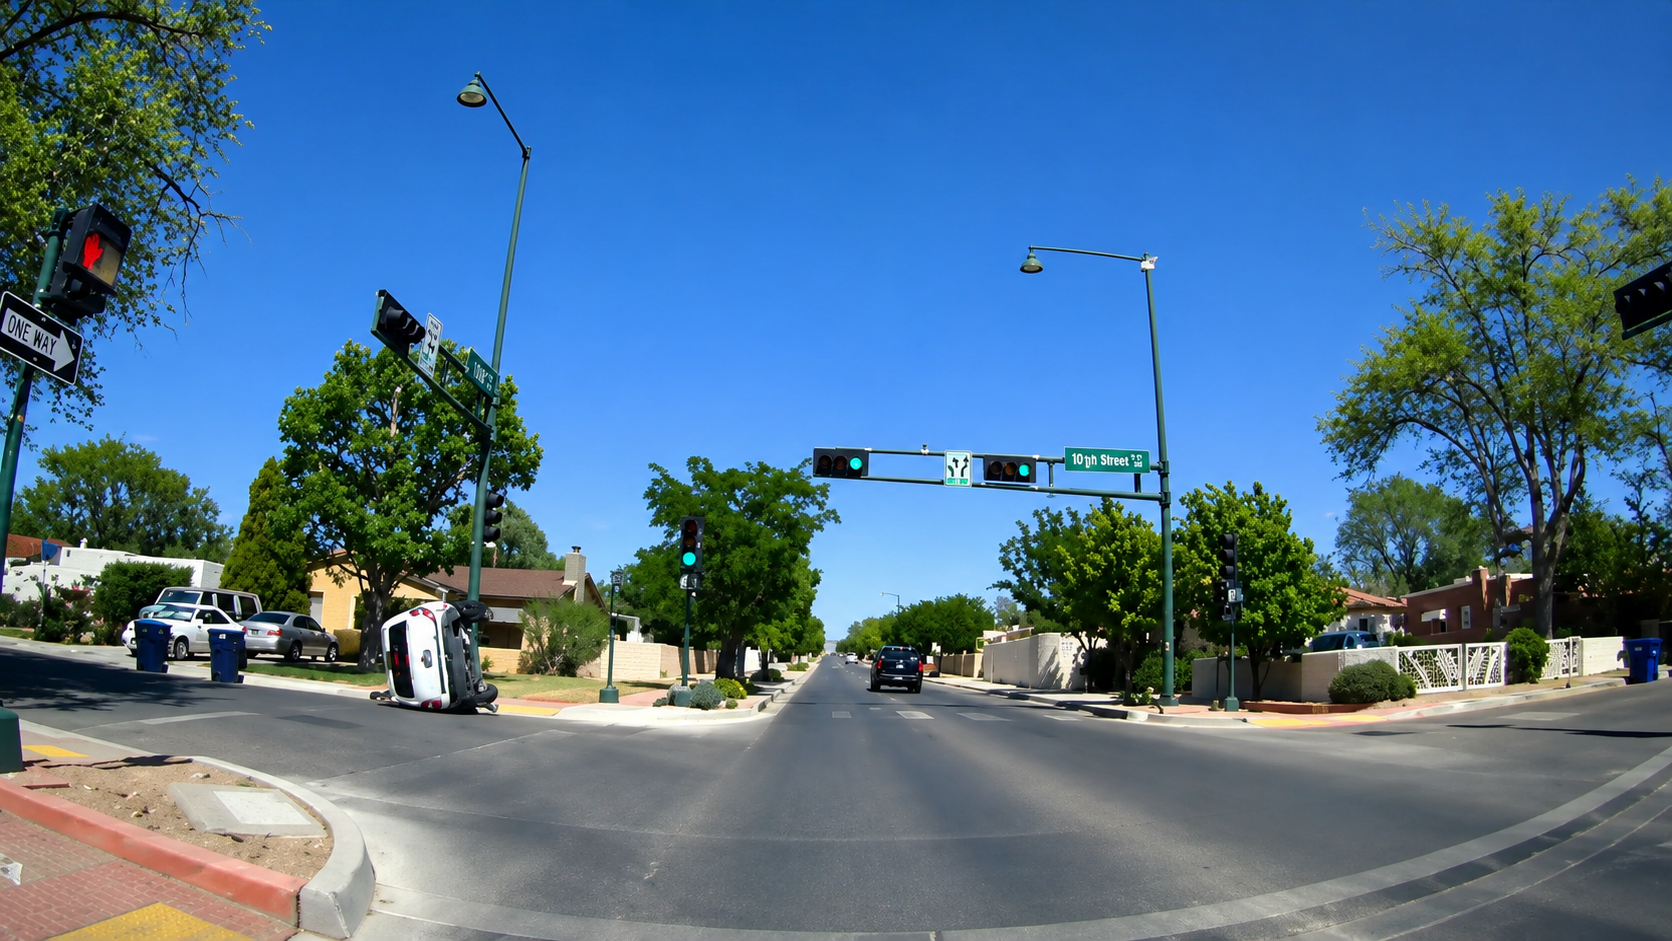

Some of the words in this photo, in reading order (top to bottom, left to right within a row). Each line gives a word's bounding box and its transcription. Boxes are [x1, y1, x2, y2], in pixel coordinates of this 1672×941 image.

[8, 315, 32, 343] ONE
[33, 329, 57, 356] WAY
[1100, 454, 1130, 467] Street
